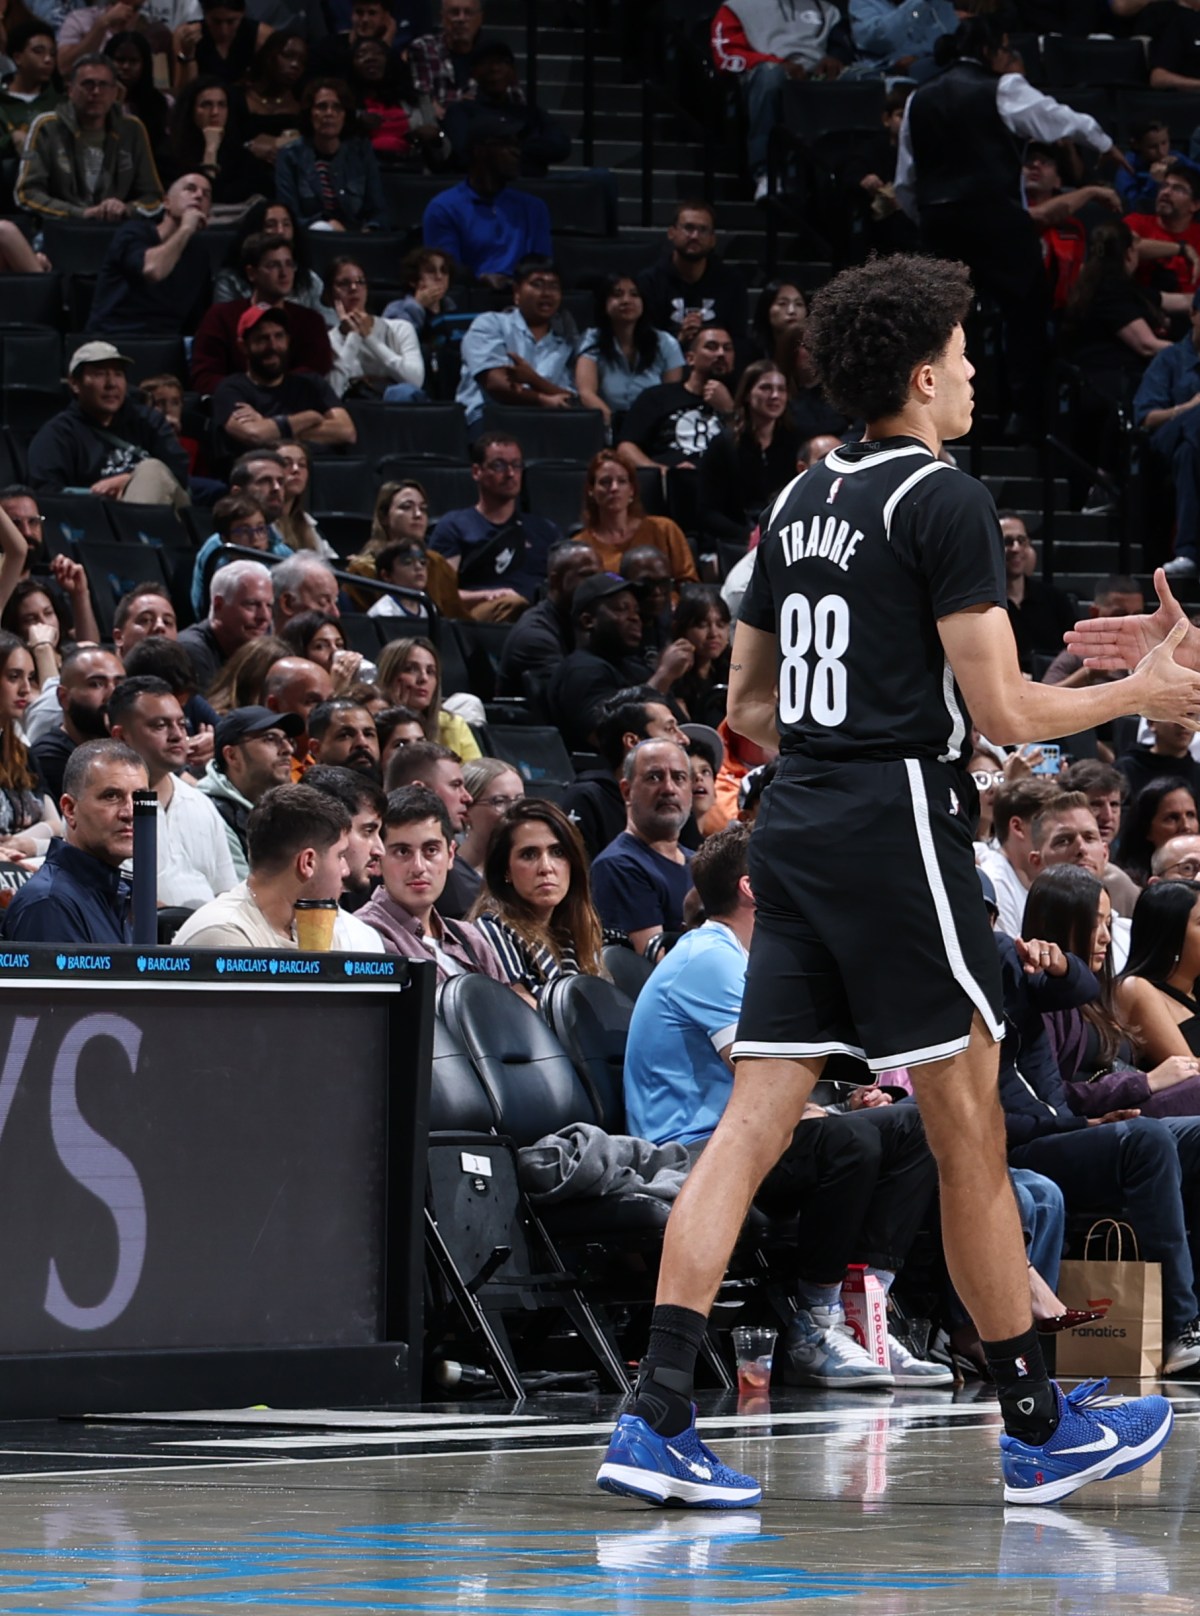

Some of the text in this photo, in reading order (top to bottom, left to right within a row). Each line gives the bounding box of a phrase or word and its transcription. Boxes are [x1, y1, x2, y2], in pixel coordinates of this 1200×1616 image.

[778, 515, 865, 572] TRAORE
[779, 592, 849, 727] 88
[67, 956, 111, 970] BARCLAYS
[147, 957, 190, 971] BARCLAYS
[226, 958, 268, 973] BARCLAYS
[279, 960, 320, 974] BARCLAYS
[354, 961, 394, 975] BARCLAYS
[873, 1302, 885, 1367] POPCOR
